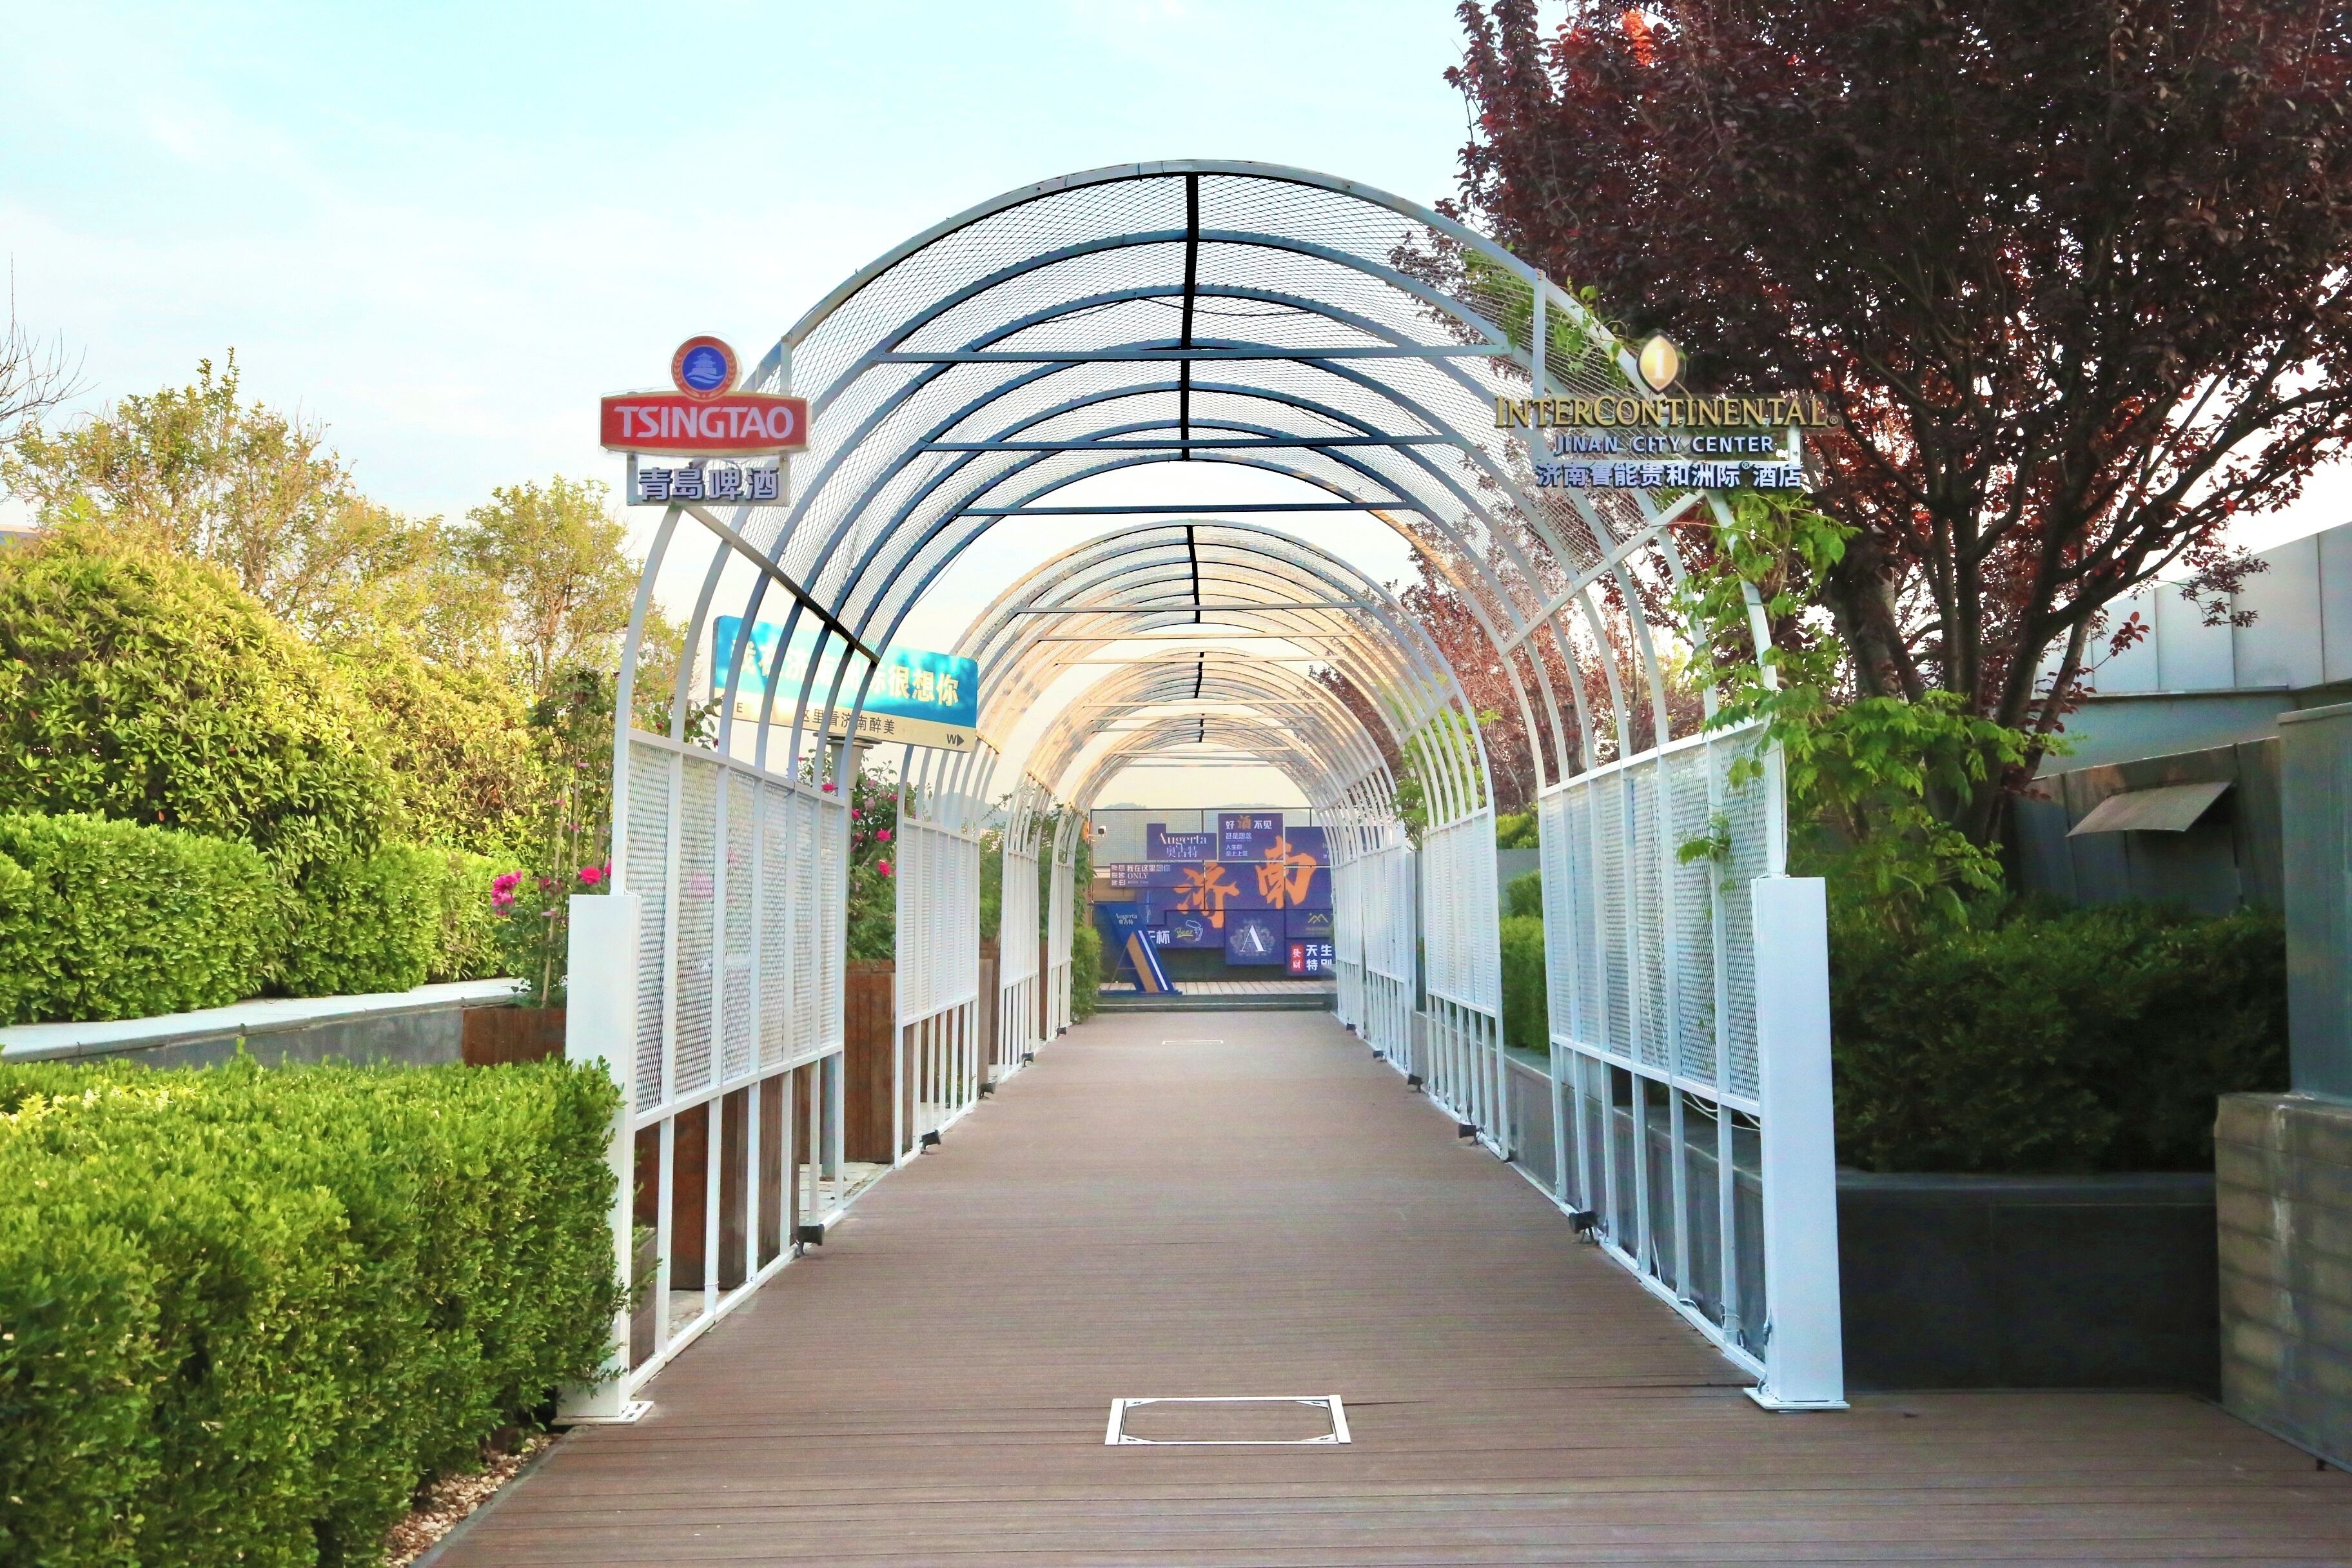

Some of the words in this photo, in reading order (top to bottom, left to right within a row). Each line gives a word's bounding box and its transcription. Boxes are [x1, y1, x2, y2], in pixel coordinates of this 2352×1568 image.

[614, 406, 794, 438] TSINGTAO
[1556, 436, 1617, 454] JINAN
[1633, 436, 1680, 453] CITY
[1693, 436, 1774, 451] CENTER
[736, 702, 743, 713] E
[946, 733, 957, 745] W
[1159, 833, 1207, 847] Augerta
